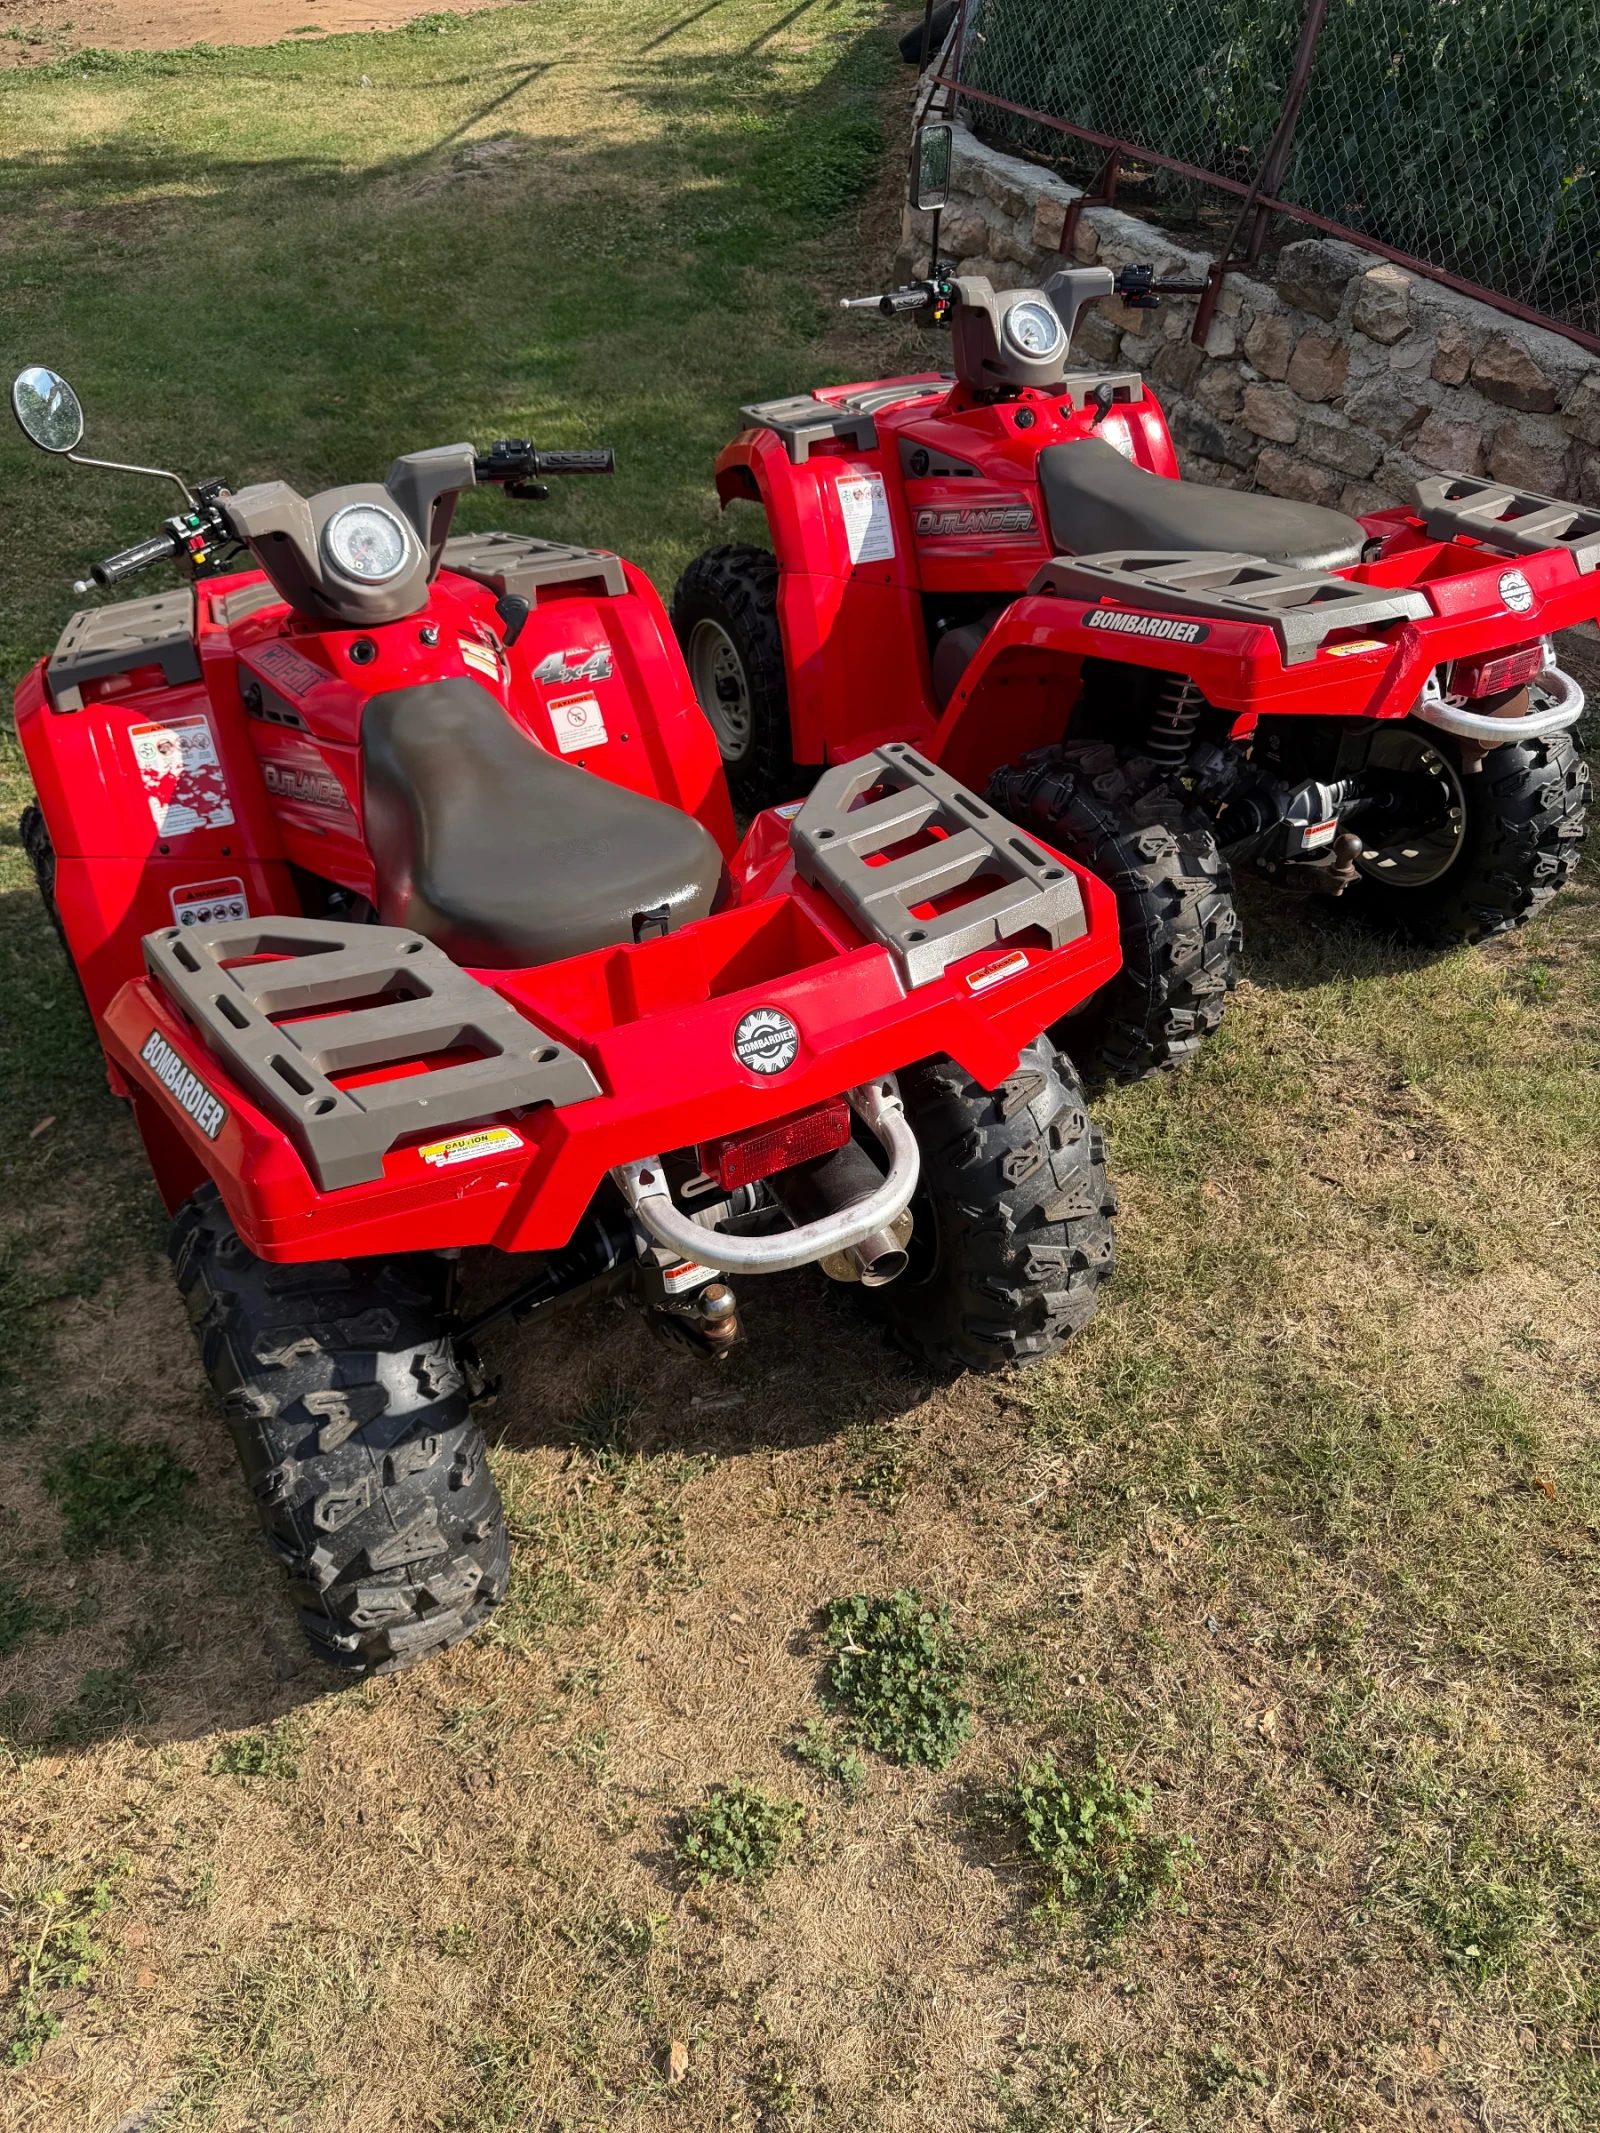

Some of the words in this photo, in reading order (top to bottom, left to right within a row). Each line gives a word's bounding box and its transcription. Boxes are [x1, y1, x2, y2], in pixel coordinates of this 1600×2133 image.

[917, 510, 1033, 535] OUTLANDER
[1088, 610, 1200, 643] BOMBARDIER
[532, 649, 614, 685] 4x4
[737, 1028, 796, 1056] BOMBARDIER
[141, 1030, 225, 1138] BOMBARDIER
